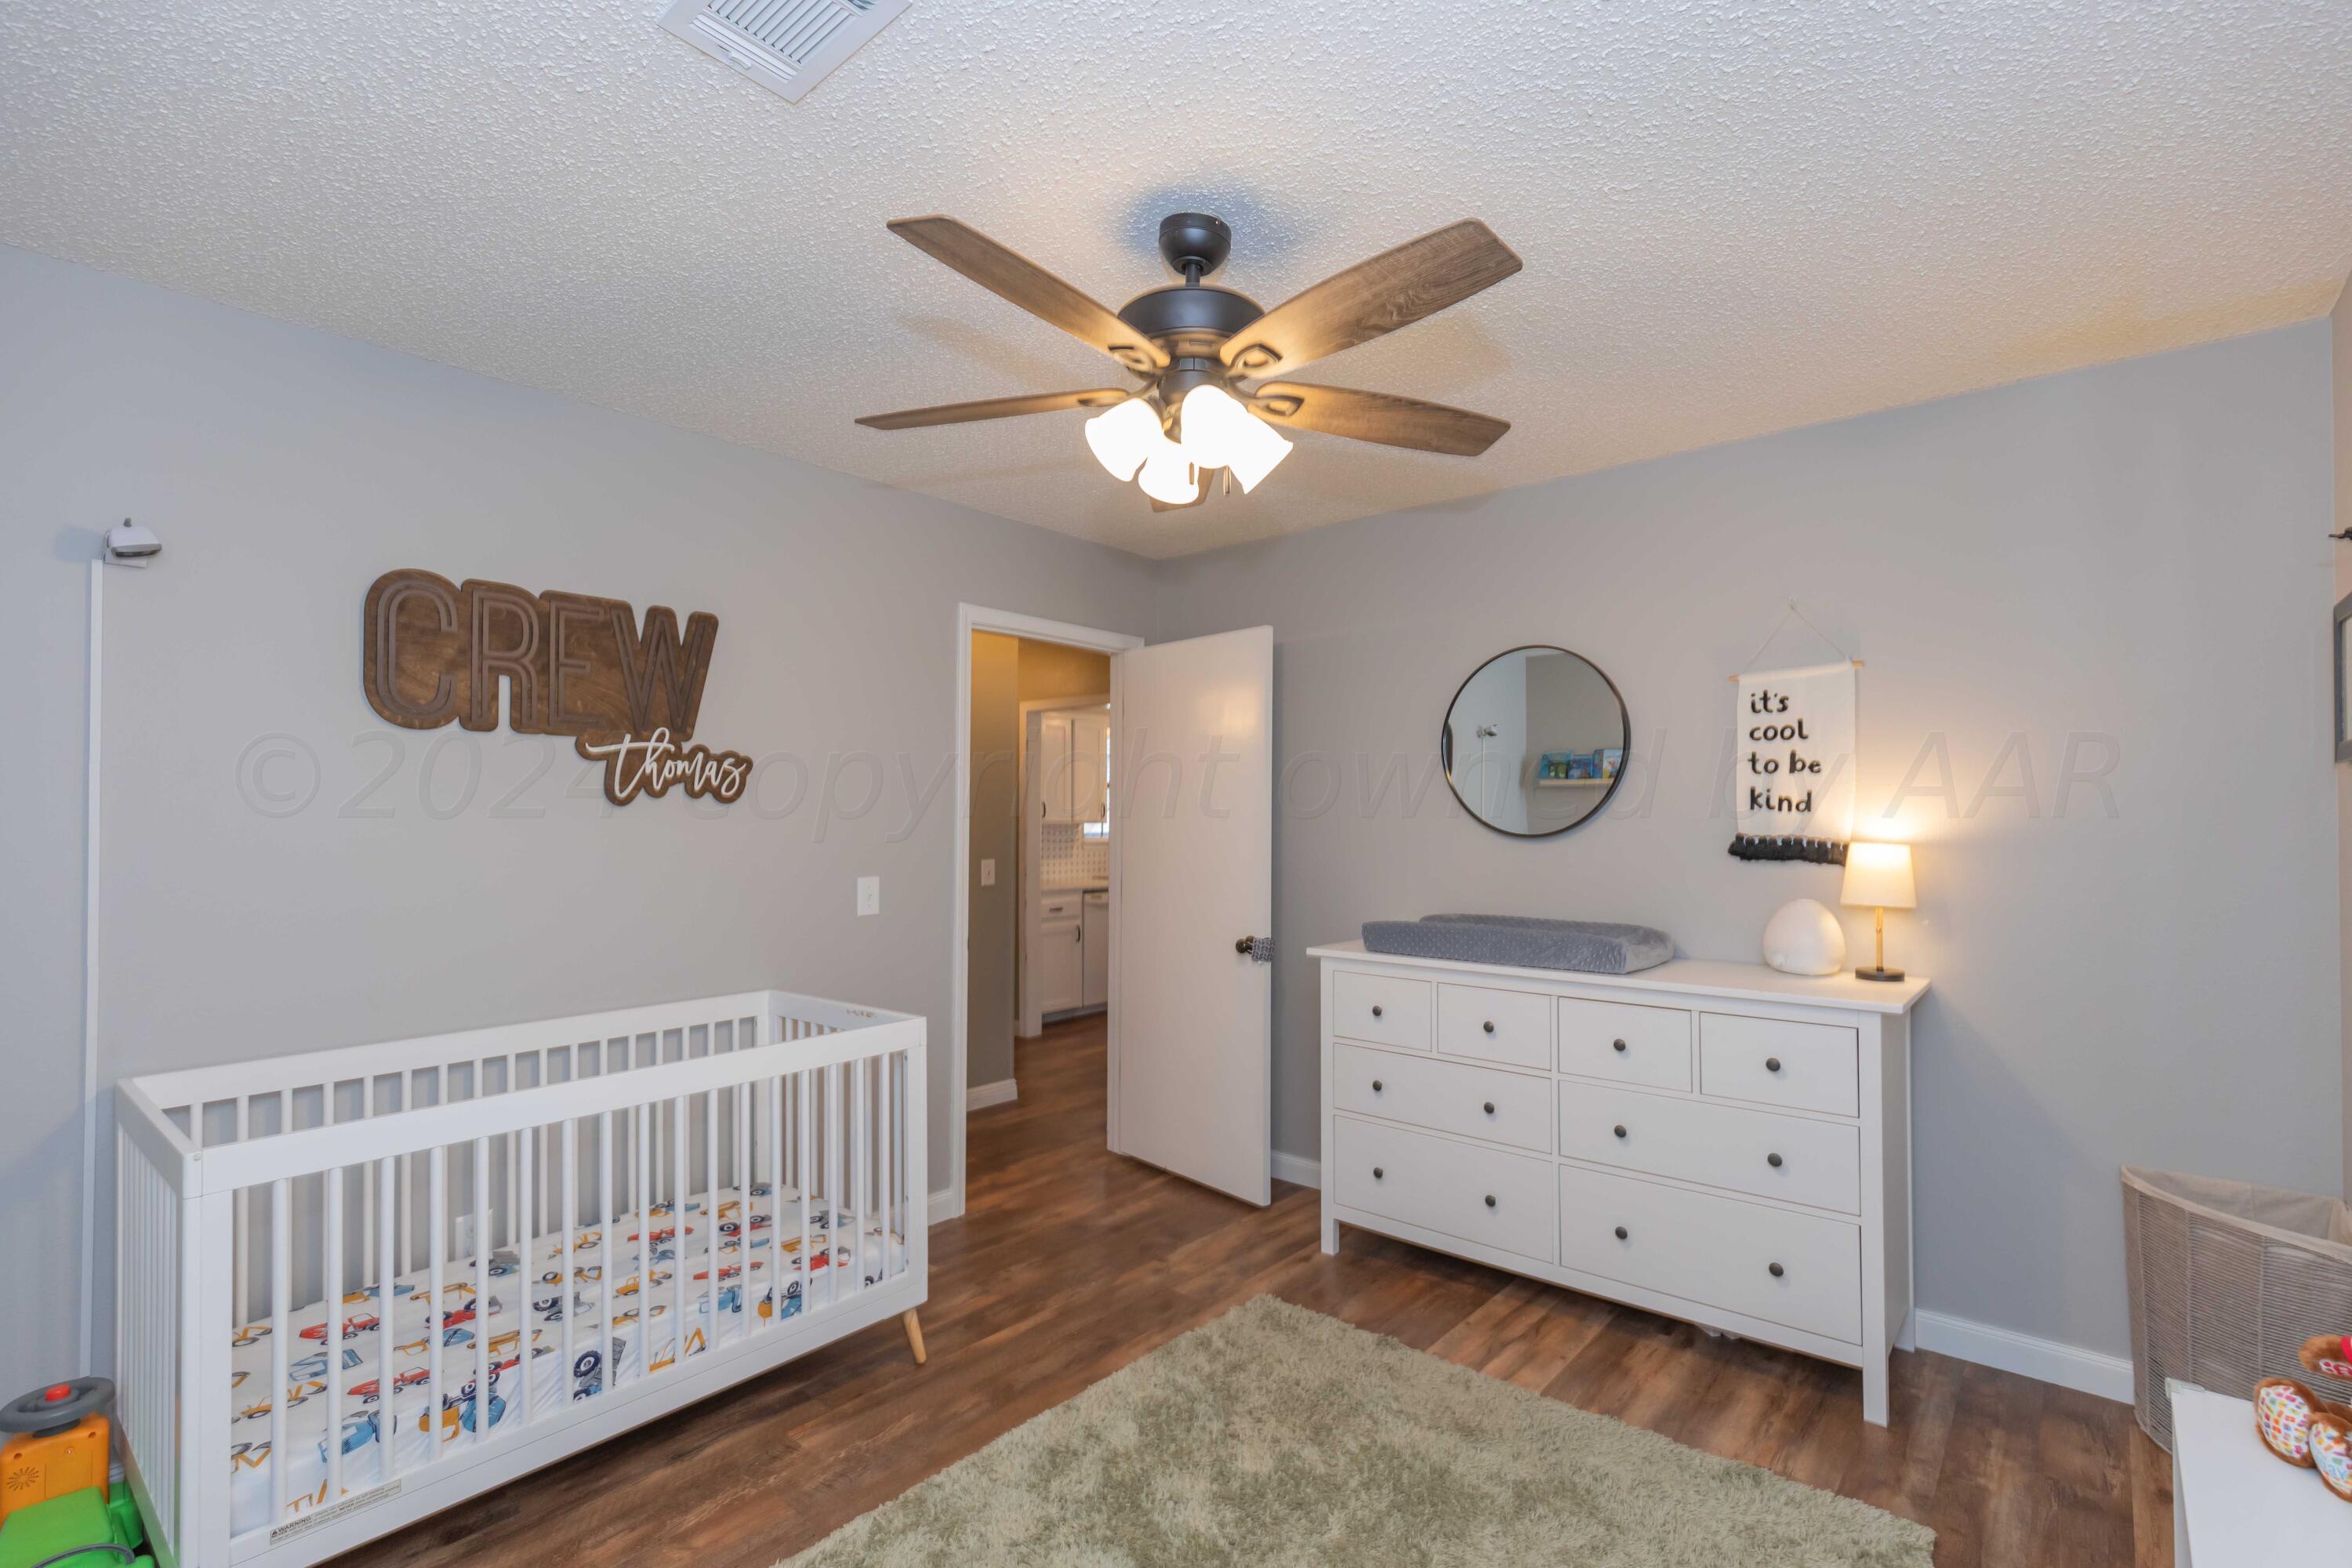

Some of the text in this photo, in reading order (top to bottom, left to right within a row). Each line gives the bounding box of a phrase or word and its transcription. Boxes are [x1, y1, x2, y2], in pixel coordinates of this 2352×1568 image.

[376, 579, 707, 735] CREW
[1750, 689, 1789, 714] it's
[1749, 718, 1809, 741] cool
[585, 727, 746, 798] thomas
[1748, 749, 1822, 775] to be
[1750, 786, 1813, 812] kind
